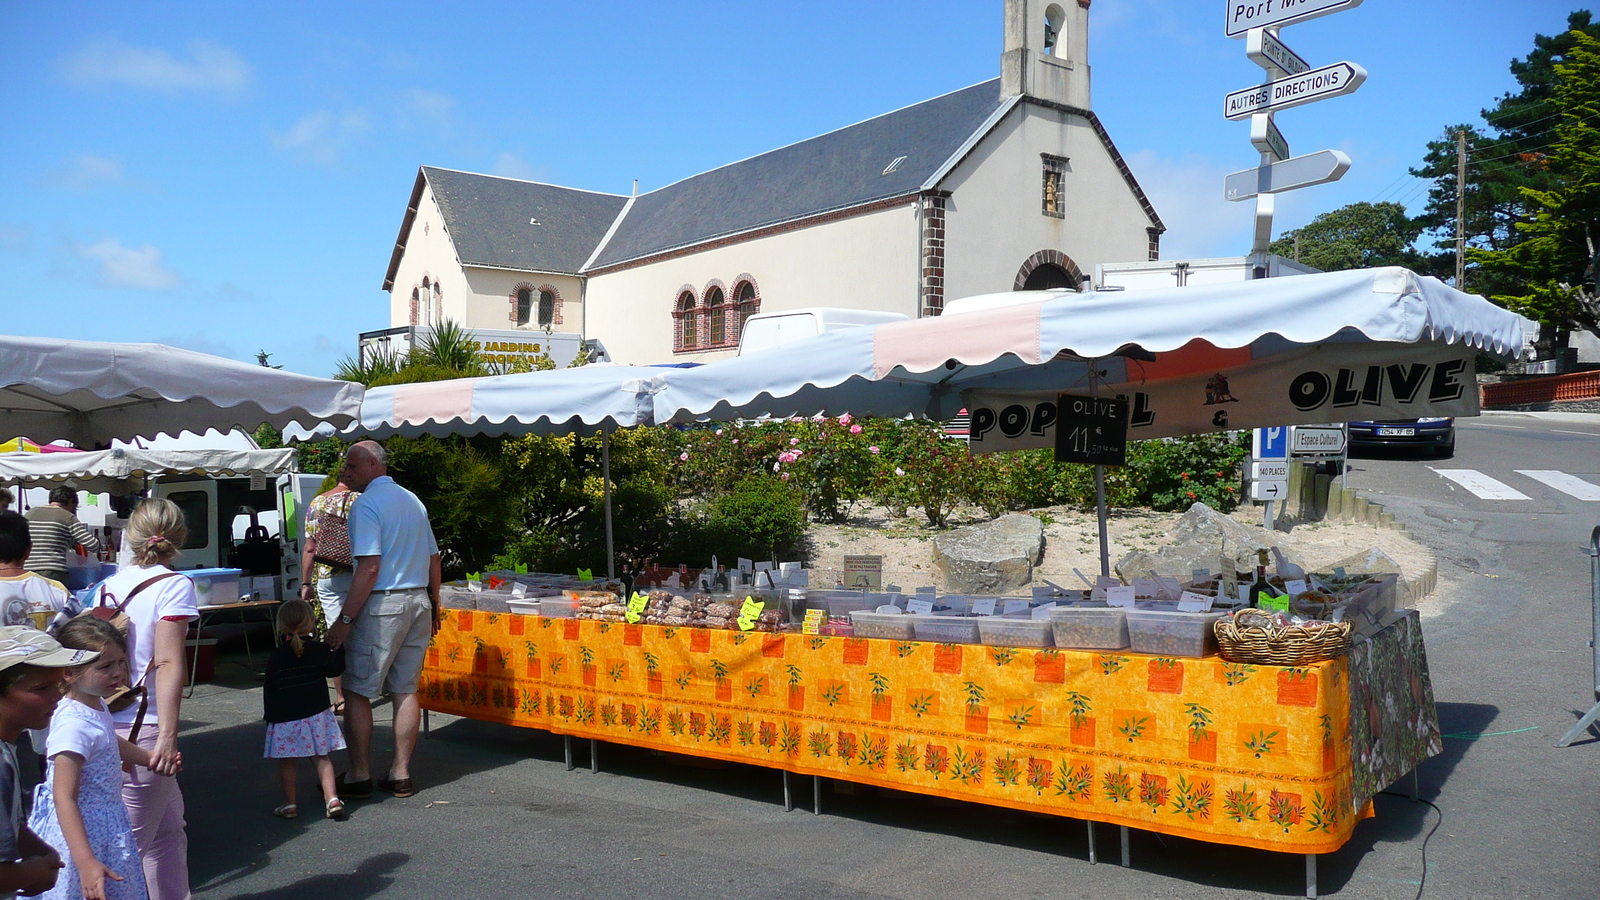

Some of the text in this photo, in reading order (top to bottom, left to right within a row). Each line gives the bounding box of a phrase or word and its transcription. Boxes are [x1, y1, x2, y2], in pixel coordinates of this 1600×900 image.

[1234, 0, 1272, 23] Port
[1264, 37, 1280, 60] POINTE
[1230, 72, 1339, 111] AUTRES DIRECTIONS
[484, 341, 541, 353] JARDINS
[1212, 409, 1228, 428] &
[1289, 359, 1467, 412] OLIVE
[1073, 397, 1116, 418] OLIVE
[1266, 427, 1280, 449] P
[1320, 433, 1339, 445] Culturel
[1260, 467, 1286, 476] 140 PLACES
